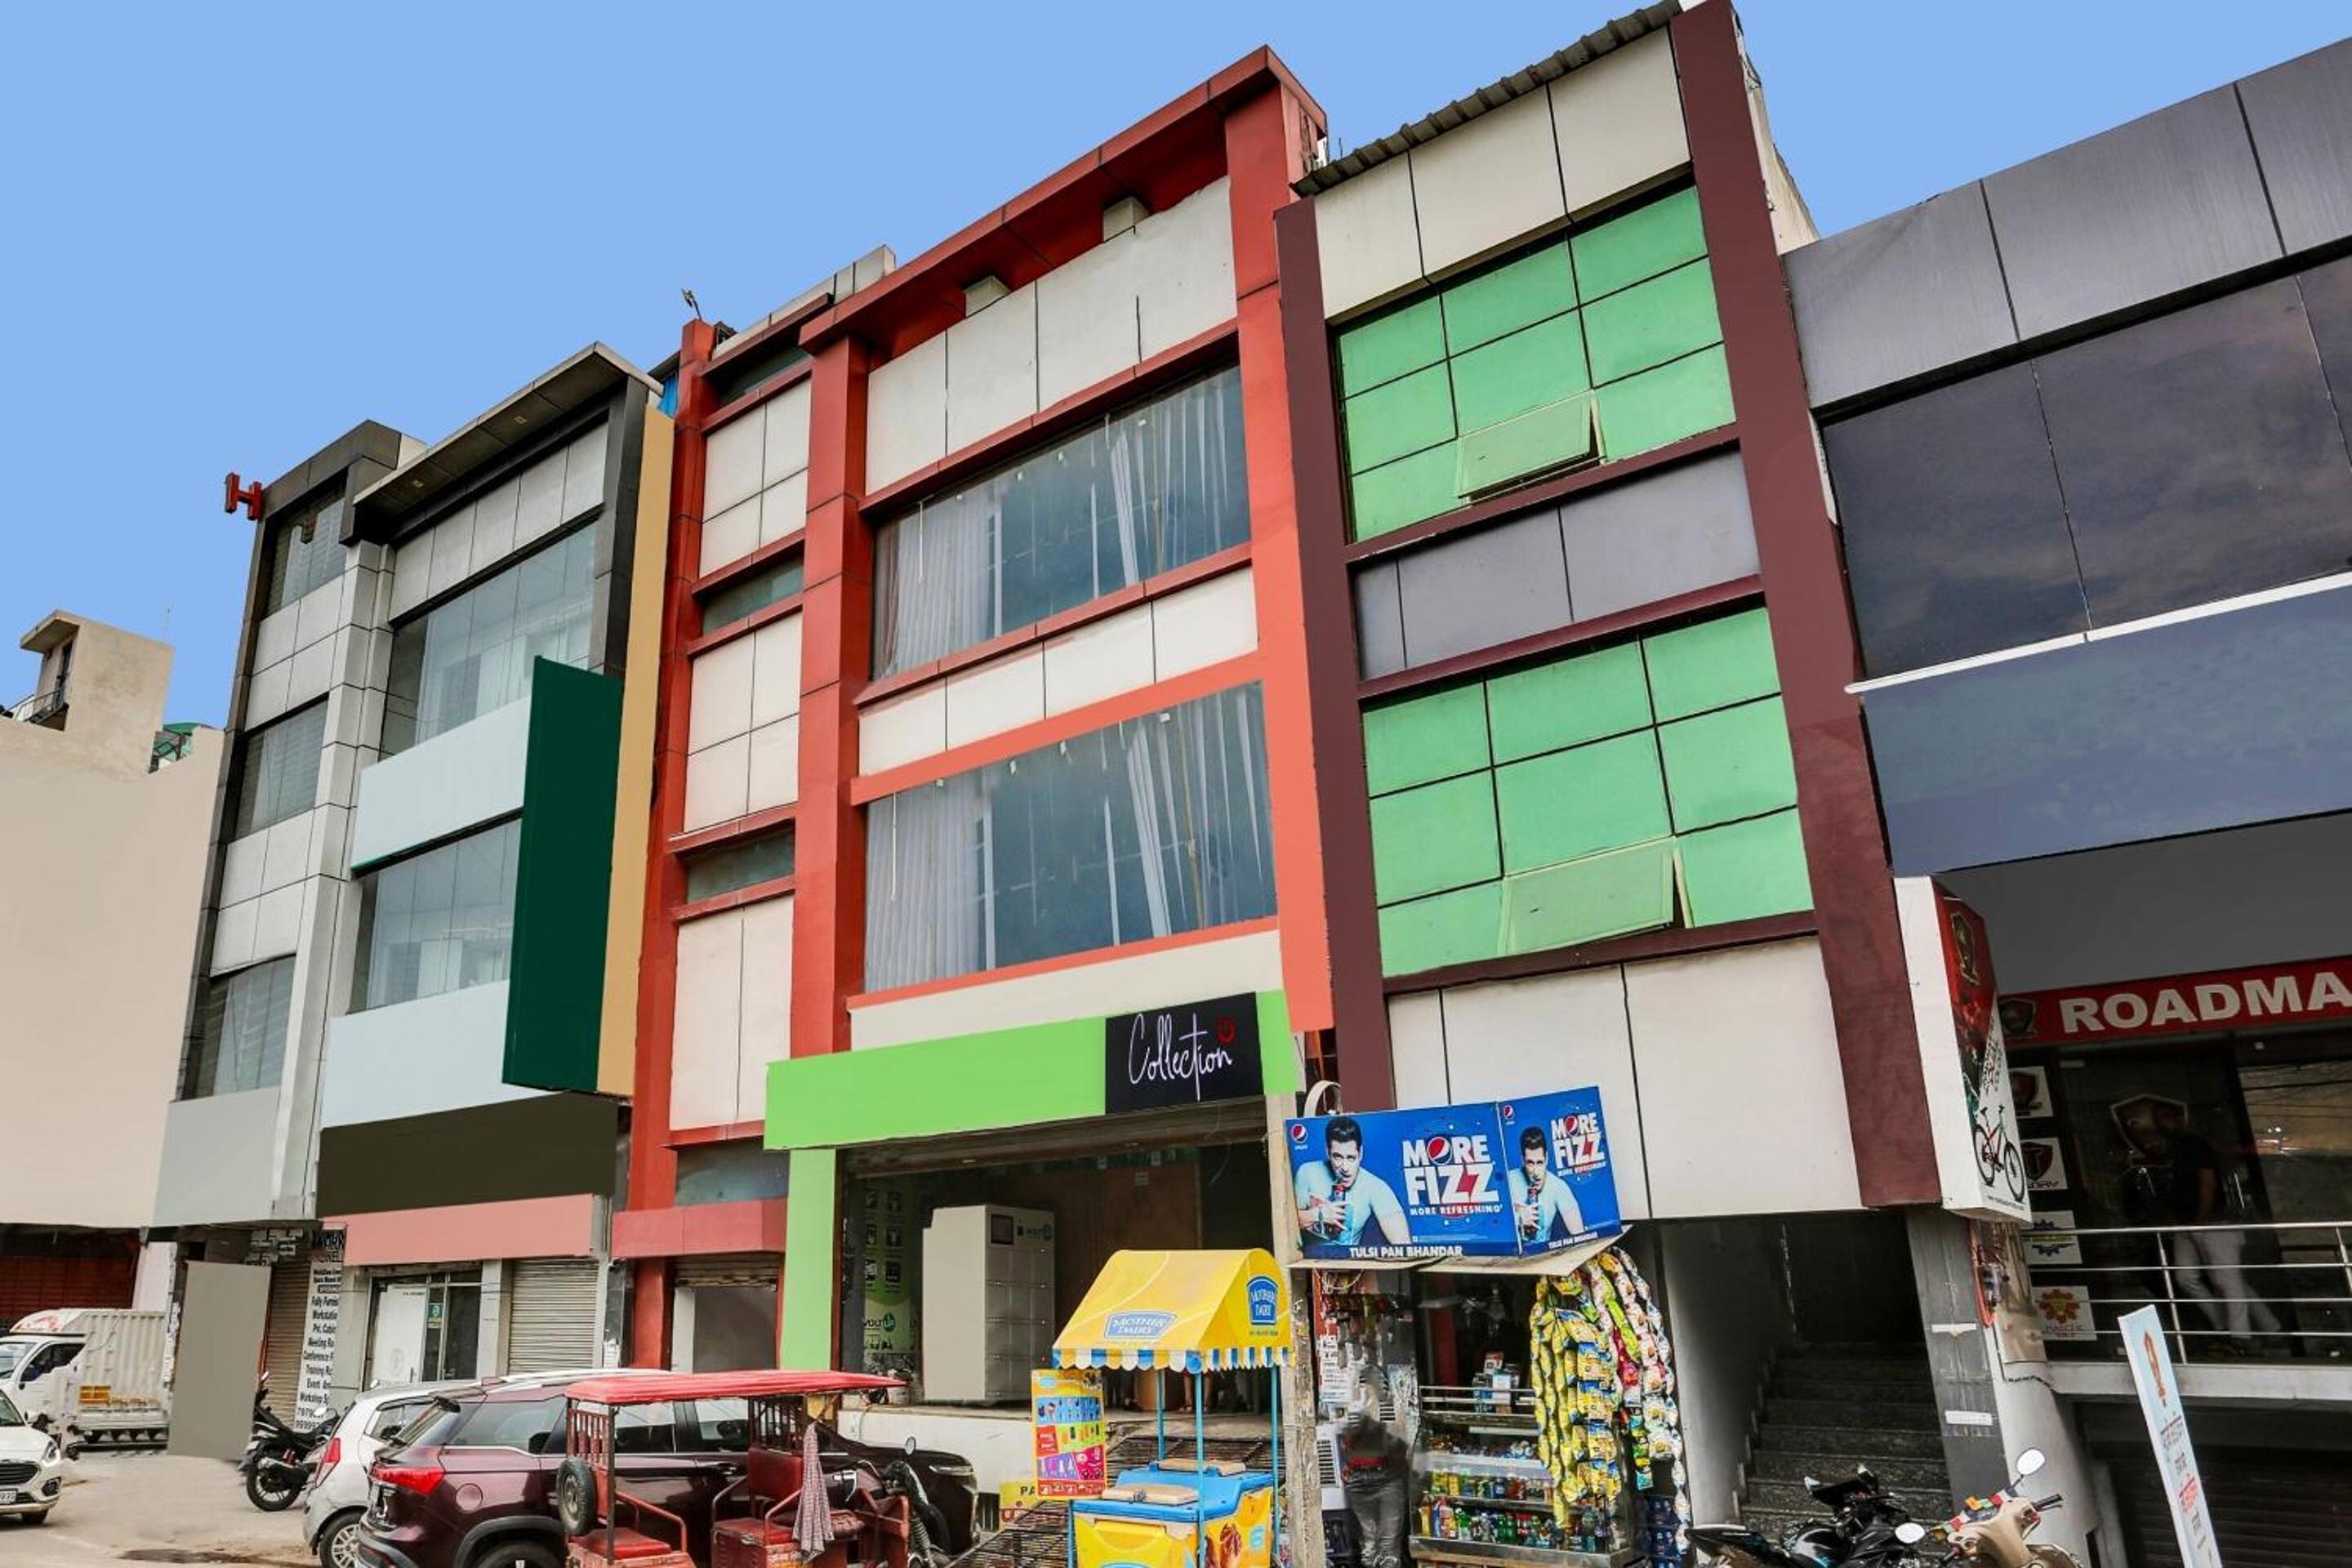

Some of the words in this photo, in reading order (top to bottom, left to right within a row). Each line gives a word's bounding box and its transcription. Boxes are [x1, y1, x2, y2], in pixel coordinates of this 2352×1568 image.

[2059, 972, 2352, 1034] ROADMA
[1129, 1013, 1232, 1102] Collection
[1551, 1111, 1599, 1140] MORE
[1402, 1134, 1490, 1167] MORE
[1552, 1132, 1606, 1169] FIZZ
[1405, 1163, 1500, 1206] FIZZ
[1410, 1207, 1436, 1216] MORE
[1349, 1246, 1378, 1258] TULSI
[1381, 1246, 1403, 1258] PAN
[1407, 1245, 1463, 1258] BHANDAR
